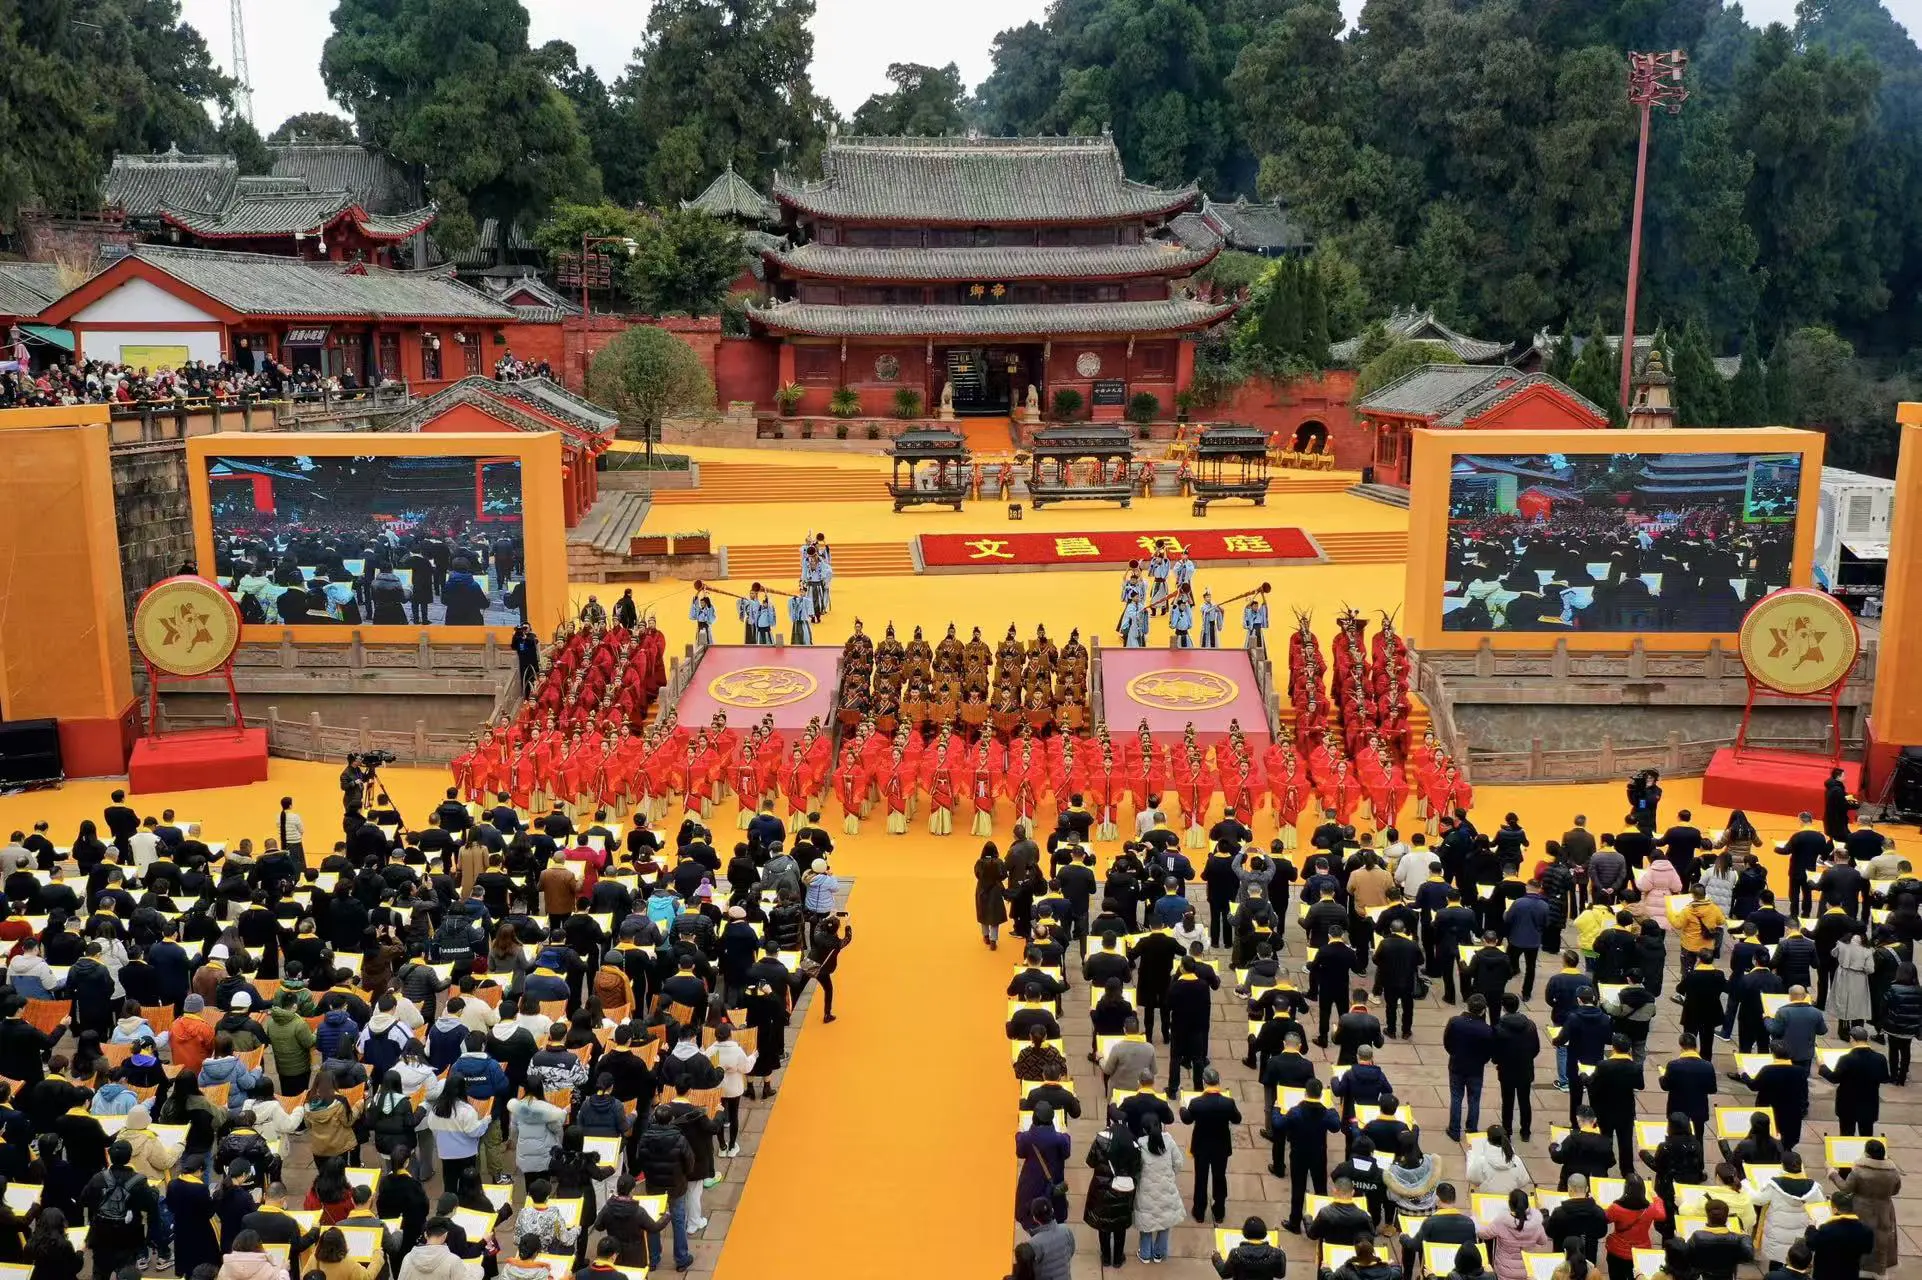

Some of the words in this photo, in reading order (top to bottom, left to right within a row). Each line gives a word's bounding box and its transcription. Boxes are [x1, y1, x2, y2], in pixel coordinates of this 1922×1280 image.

[963, 534, 1276, 559] 文昌祖庭
[1352, 1180, 1377, 1190] HINA
